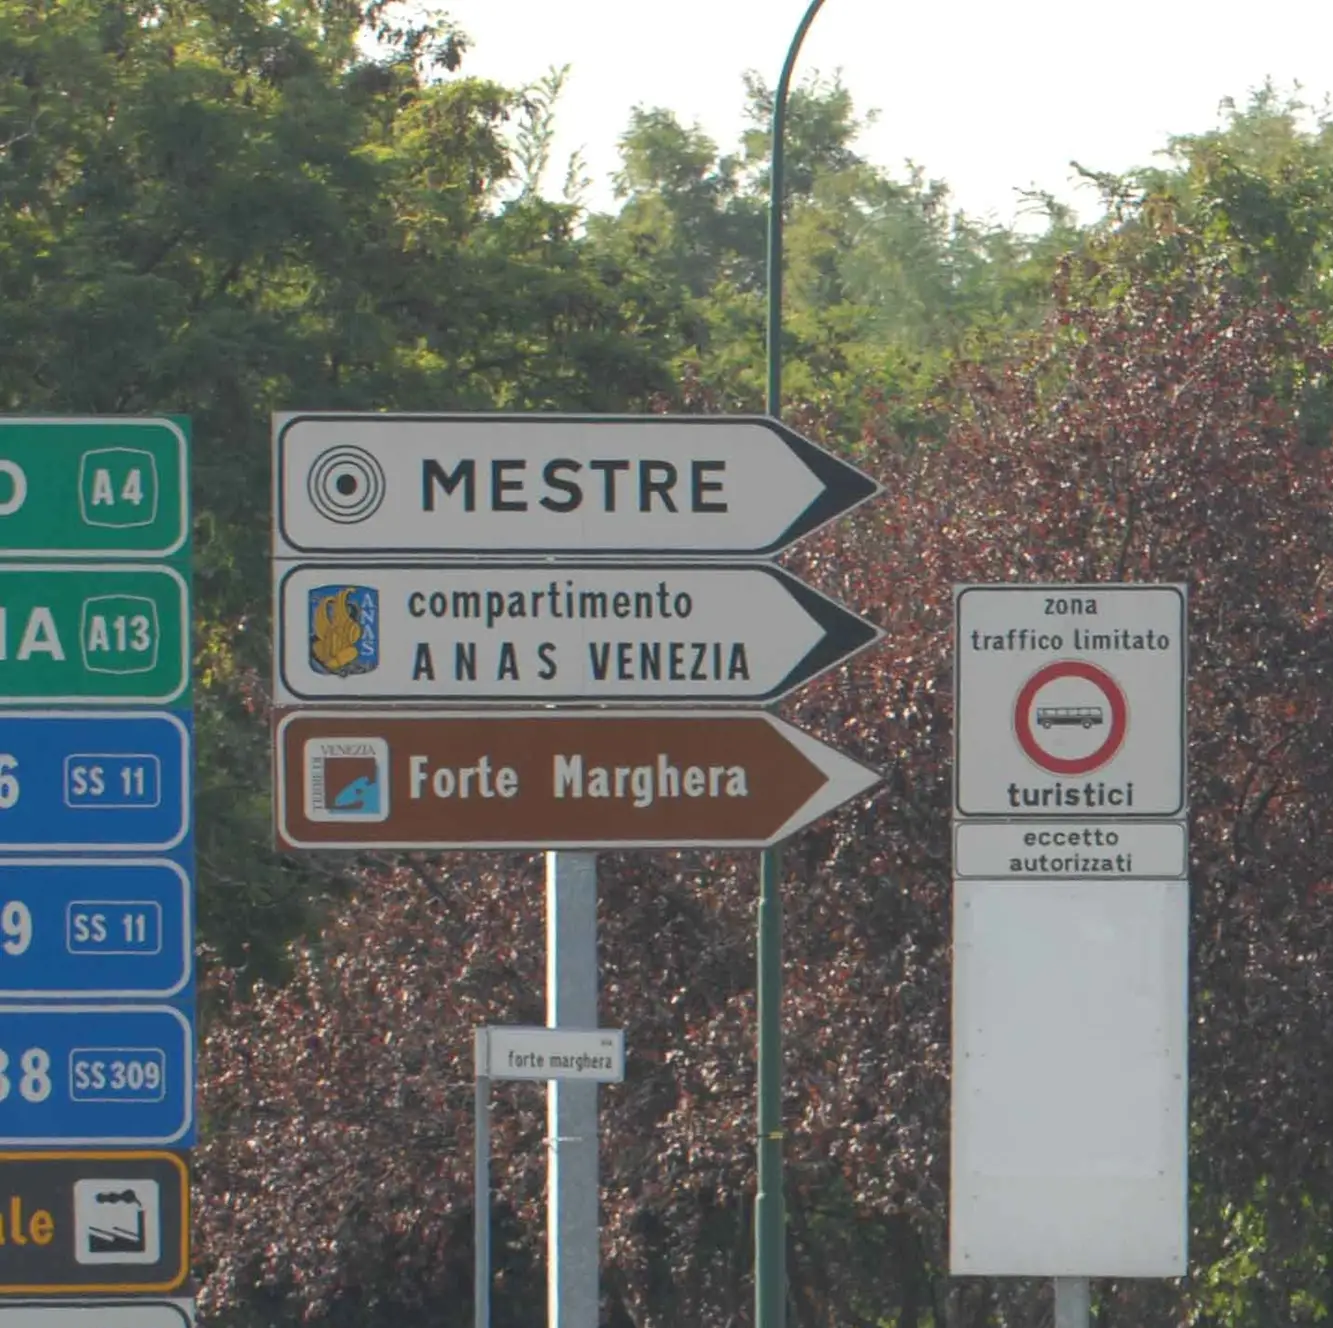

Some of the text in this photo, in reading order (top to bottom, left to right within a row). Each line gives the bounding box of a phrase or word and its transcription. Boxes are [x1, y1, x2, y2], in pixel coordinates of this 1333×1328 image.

[421, 458, 728, 513] MESTRE
[408, 580, 693, 627] compartimento
[1044, 597, 1097, 615] zona
[88, 616, 151, 651] A13
[971, 629, 1170, 651] traffico limitato
[590, 642, 750, 680] VENEZIA
[72, 767, 144, 795] SS 11
[409, 754, 748, 806] Forte Marghera
[1007, 783, 1134, 807] turistici
[1024, 829, 1119, 847] eccetto
[1009, 854, 1132, 873] autorizzati
[75, 915, 145, 942] SS 11
[508, 1051, 612, 1072] forte marghera
[0, 1196, 54, 1245] le
